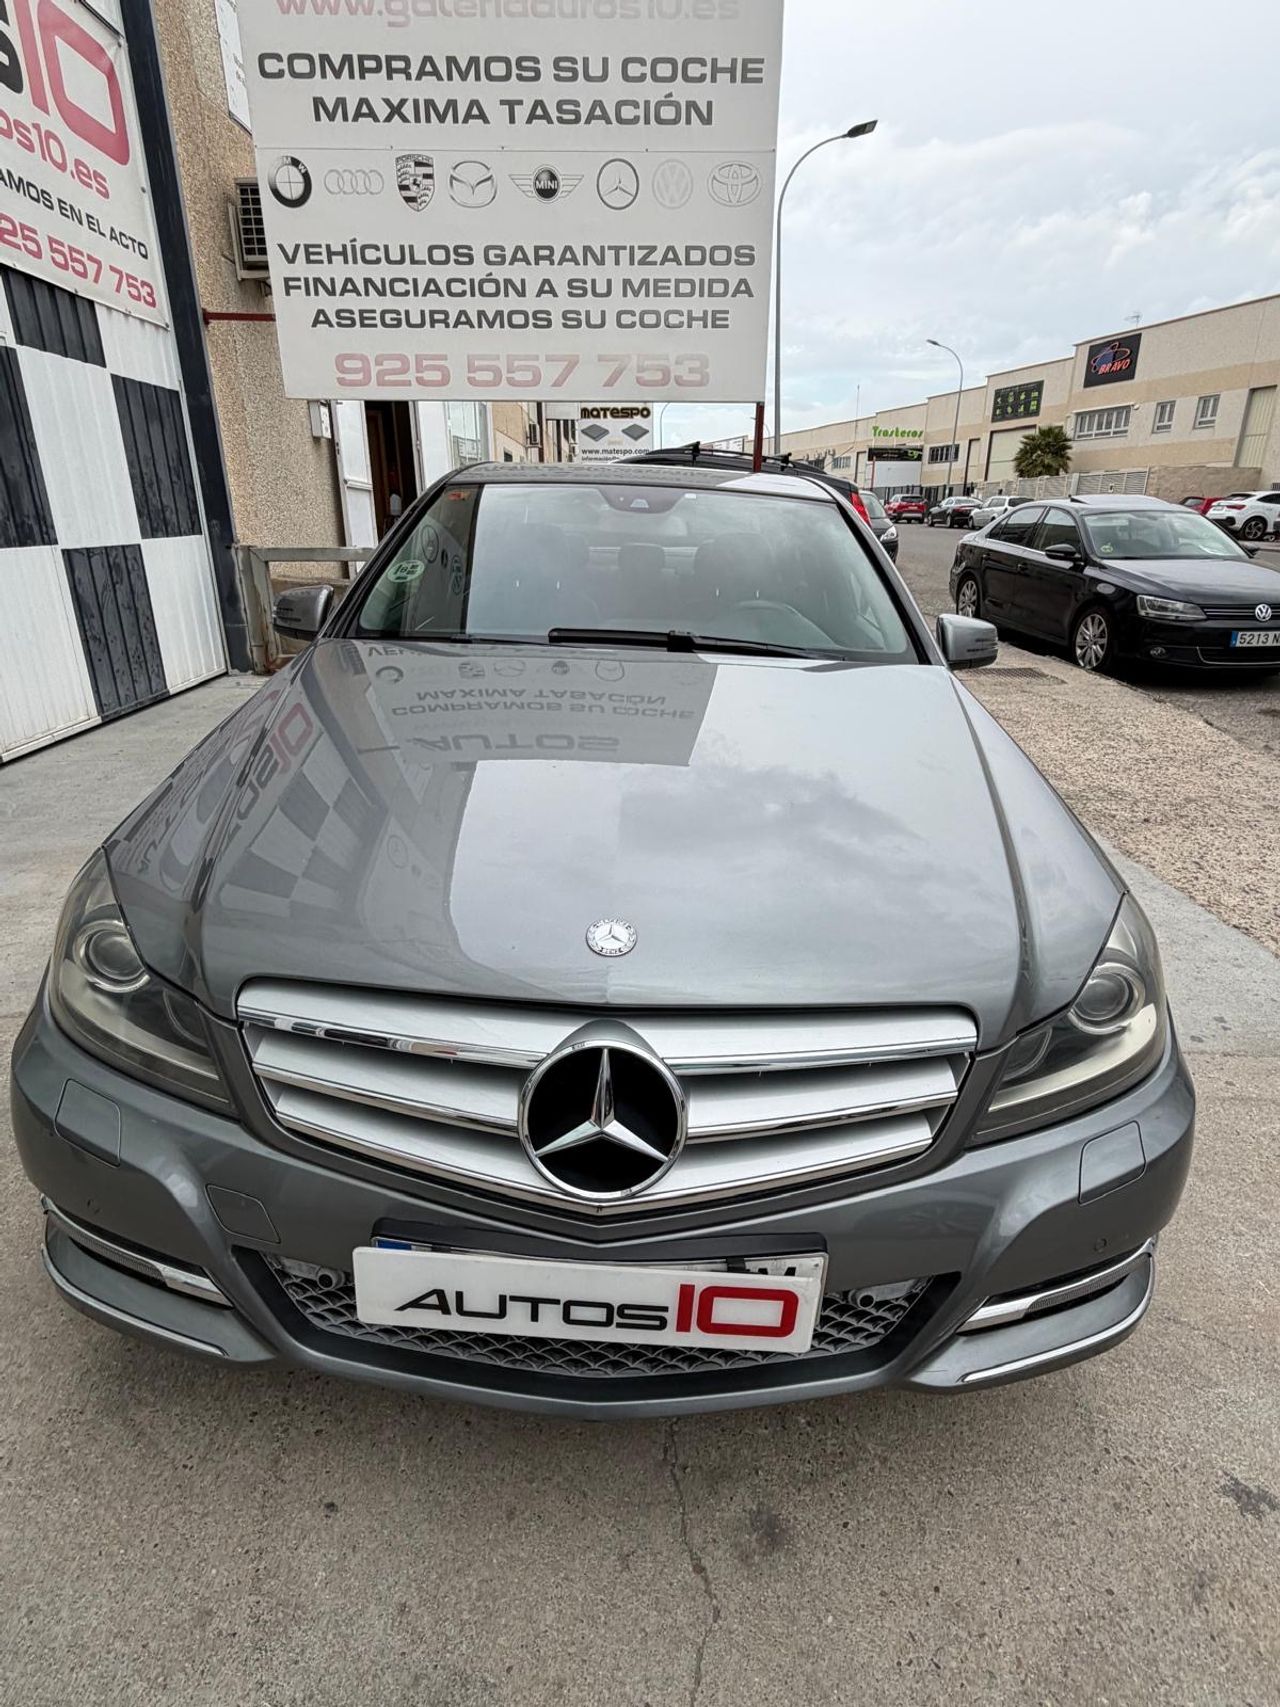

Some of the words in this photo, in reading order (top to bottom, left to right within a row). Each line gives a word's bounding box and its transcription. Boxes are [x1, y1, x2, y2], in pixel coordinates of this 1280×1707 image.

[258, 53, 541, 82] COMPRAMOS
[553, 56, 609, 83] SU
[621, 57, 765, 84] COCHE
[312, 97, 490, 124] MAXIMA
[500, 92, 713, 125] TASACIÓN
[535, 180, 558, 189] MINI
[57, 197, 84, 226] EN
[86, 213, 107, 237] EL
[109, 226, 149, 260] ACTO
[277, 238, 474, 266] VEHÍCULOS
[483, 244, 756, 266] GARANTIZADOS
[47, 235, 103, 284] 557
[109, 265, 157, 308] 753
[283, 272, 526, 298] FINANCIACIÓN
[535, 278, 559, 298] A
[567, 278, 612, 298] SU
[622, 278, 754, 298] MEDIDA
[311, 309, 553, 329] ASEGURAMOS
[561, 309, 606, 329] SU
[616, 309, 730, 329] COCHE
[335, 353, 451, 388] 925
[467, 354, 580, 388] 557
[597, 353, 711, 388] 753
[1098, 358, 1131, 375] BRAVO
[872, 426, 924, 438] Trasteros
[582, 448, 650, 456] www.matespo.com
[1239, 633, 1270, 645] 5213
[394, 1284, 799, 1337] AUTOS10
